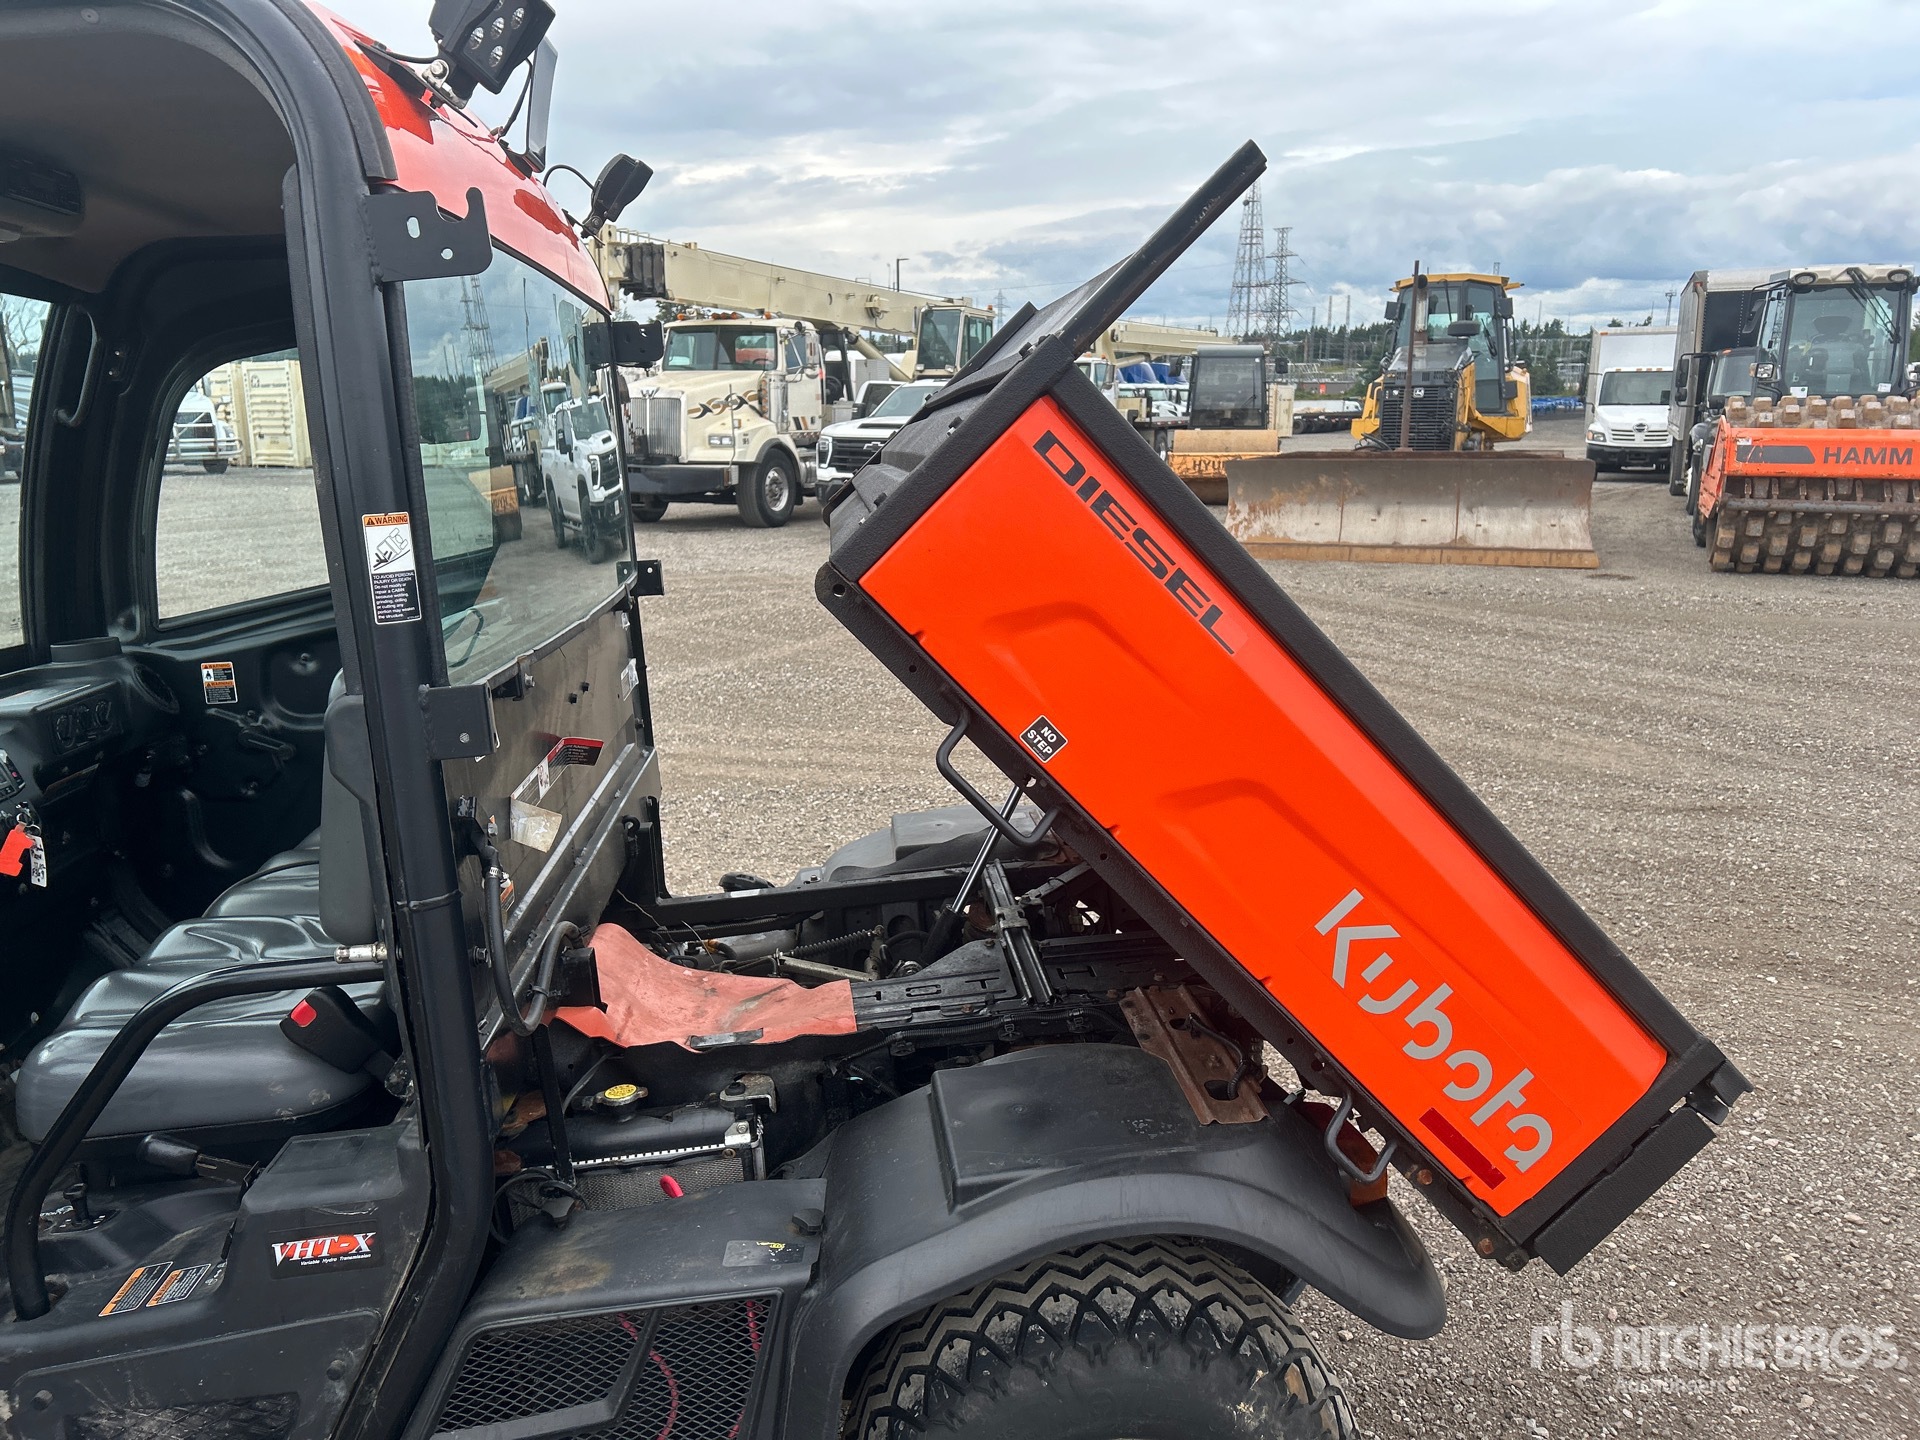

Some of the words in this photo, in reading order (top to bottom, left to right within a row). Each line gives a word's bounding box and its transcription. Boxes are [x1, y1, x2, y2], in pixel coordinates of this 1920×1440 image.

[1192, 459, 1226, 471] HYU
[1823, 446, 1914, 465] HAMM
[374, 515, 409, 524] WARNING
[1033, 430, 1235, 654] DIESEL
[1027, 729, 1053, 754] STEP
[1040, 726, 1057, 743] NO
[1314, 888, 1553, 1173] Kubota
[271, 1232, 376, 1267] VHT-X
[321, 1256, 338, 1264] Hydro
